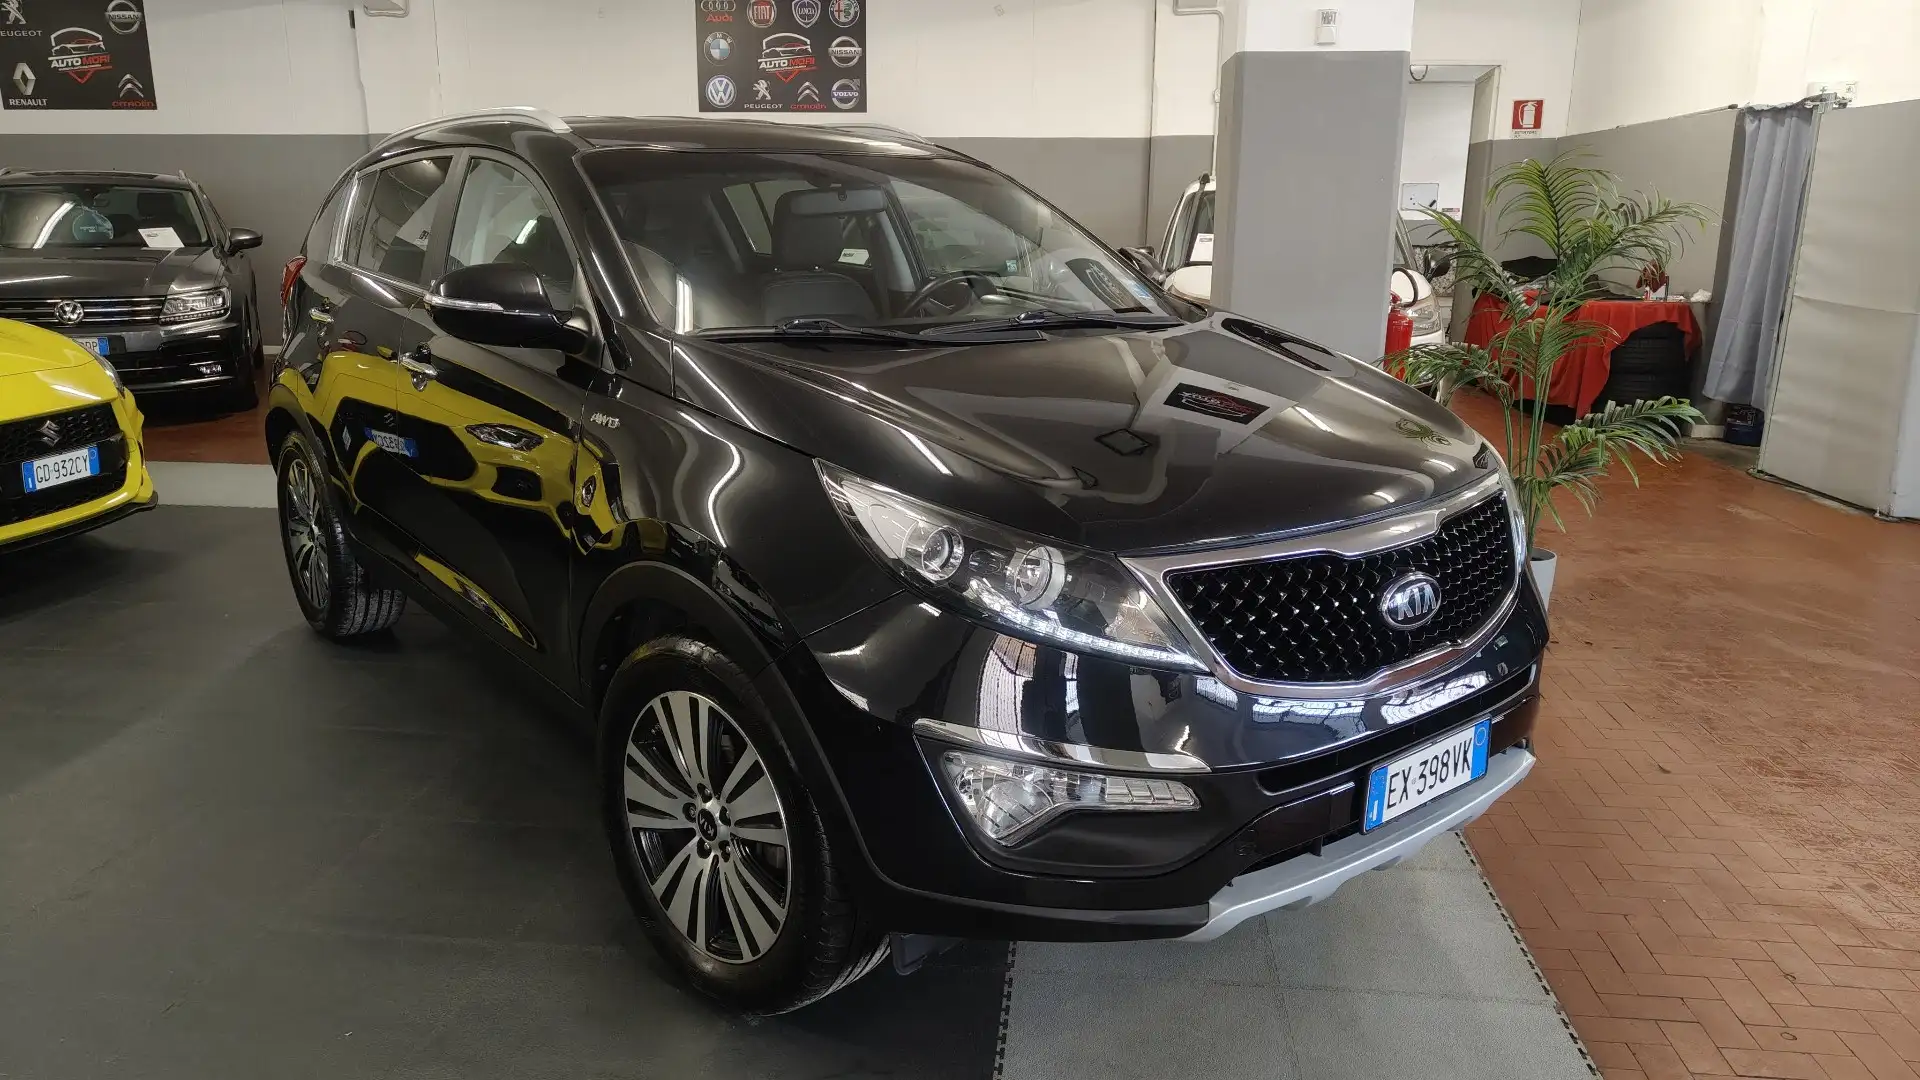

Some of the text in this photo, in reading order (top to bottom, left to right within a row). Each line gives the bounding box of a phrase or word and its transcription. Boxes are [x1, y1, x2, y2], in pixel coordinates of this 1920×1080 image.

[706, 12, 733, 22] Audi
[753, 6, 771, 20] FIAT
[798, 7, 815, 15] LANCIA
[706, 33, 733, 44] BMW
[51, 58, 81, 68] AUTO
[82, 54, 111, 65] MORI
[759, 59, 788, 69] AUTO
[789, 57, 815, 67] MORI
[9, 98, 48, 106] RENAULT
[36, 454, 88, 483] GD 932CY
[1395, 582, 1437, 620] KIA
[1387, 738, 1472, 809] EX 398VK
